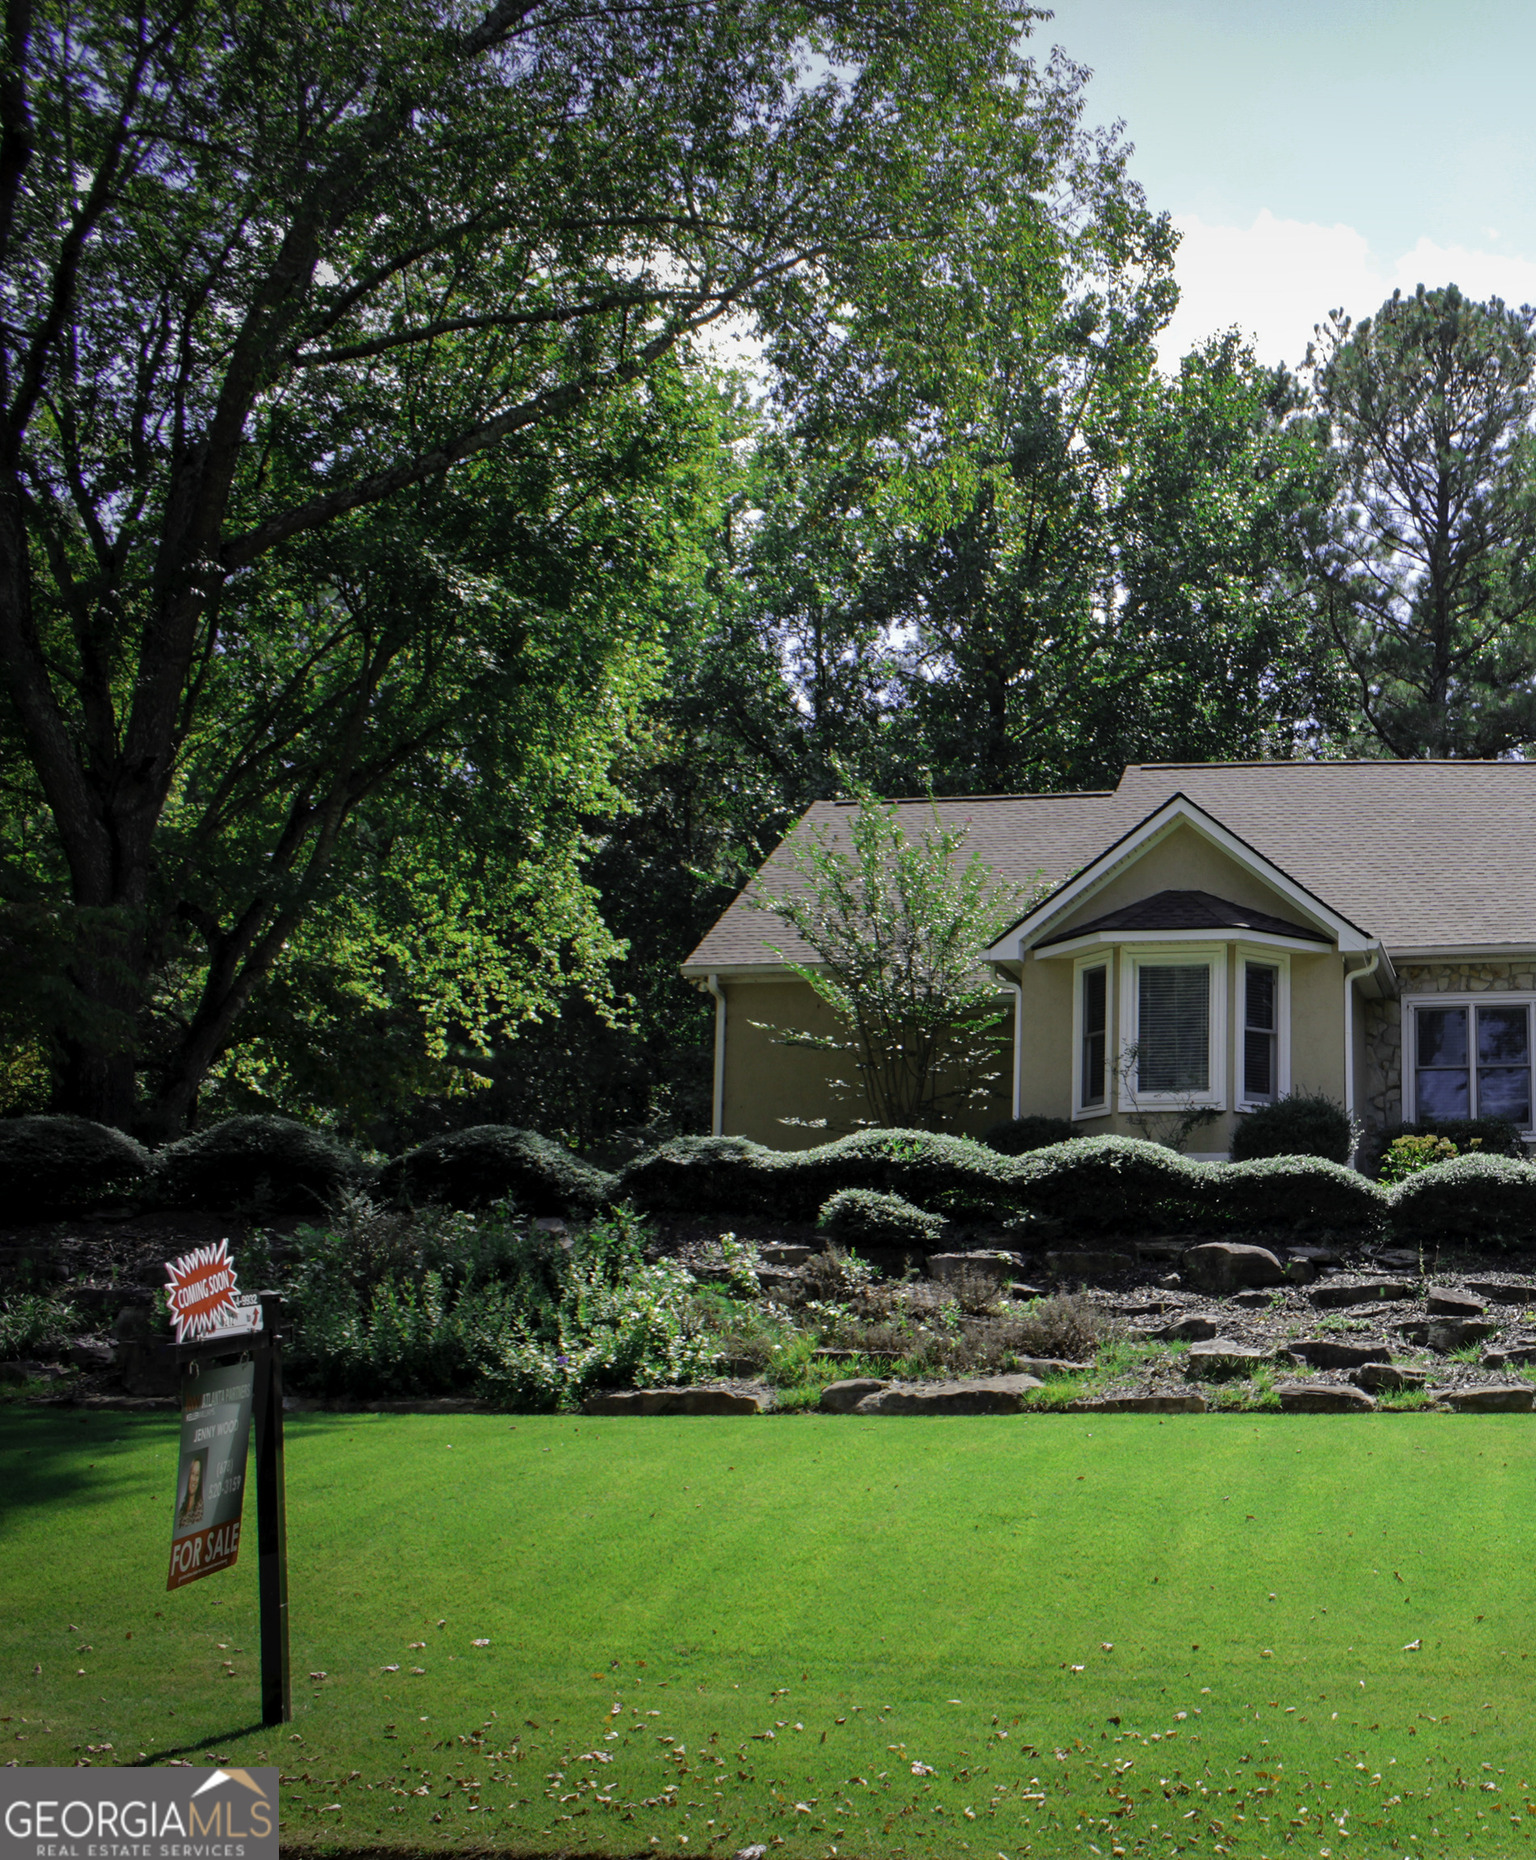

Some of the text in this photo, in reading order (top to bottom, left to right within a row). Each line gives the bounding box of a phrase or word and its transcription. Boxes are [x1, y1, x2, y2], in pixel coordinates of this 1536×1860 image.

[178, 1270, 229, 1308] COMING SOON
[202, 1389, 226, 1409] ATLANTA
[225, 1384, 250, 1402] PARTNERS
[193, 1419, 239, 1443] JENNY WOOD
[208, 1475, 242, 1501] 520-3159
[170, 1538, 202, 1576] FOR
[205, 1522, 240, 1563] SALE
